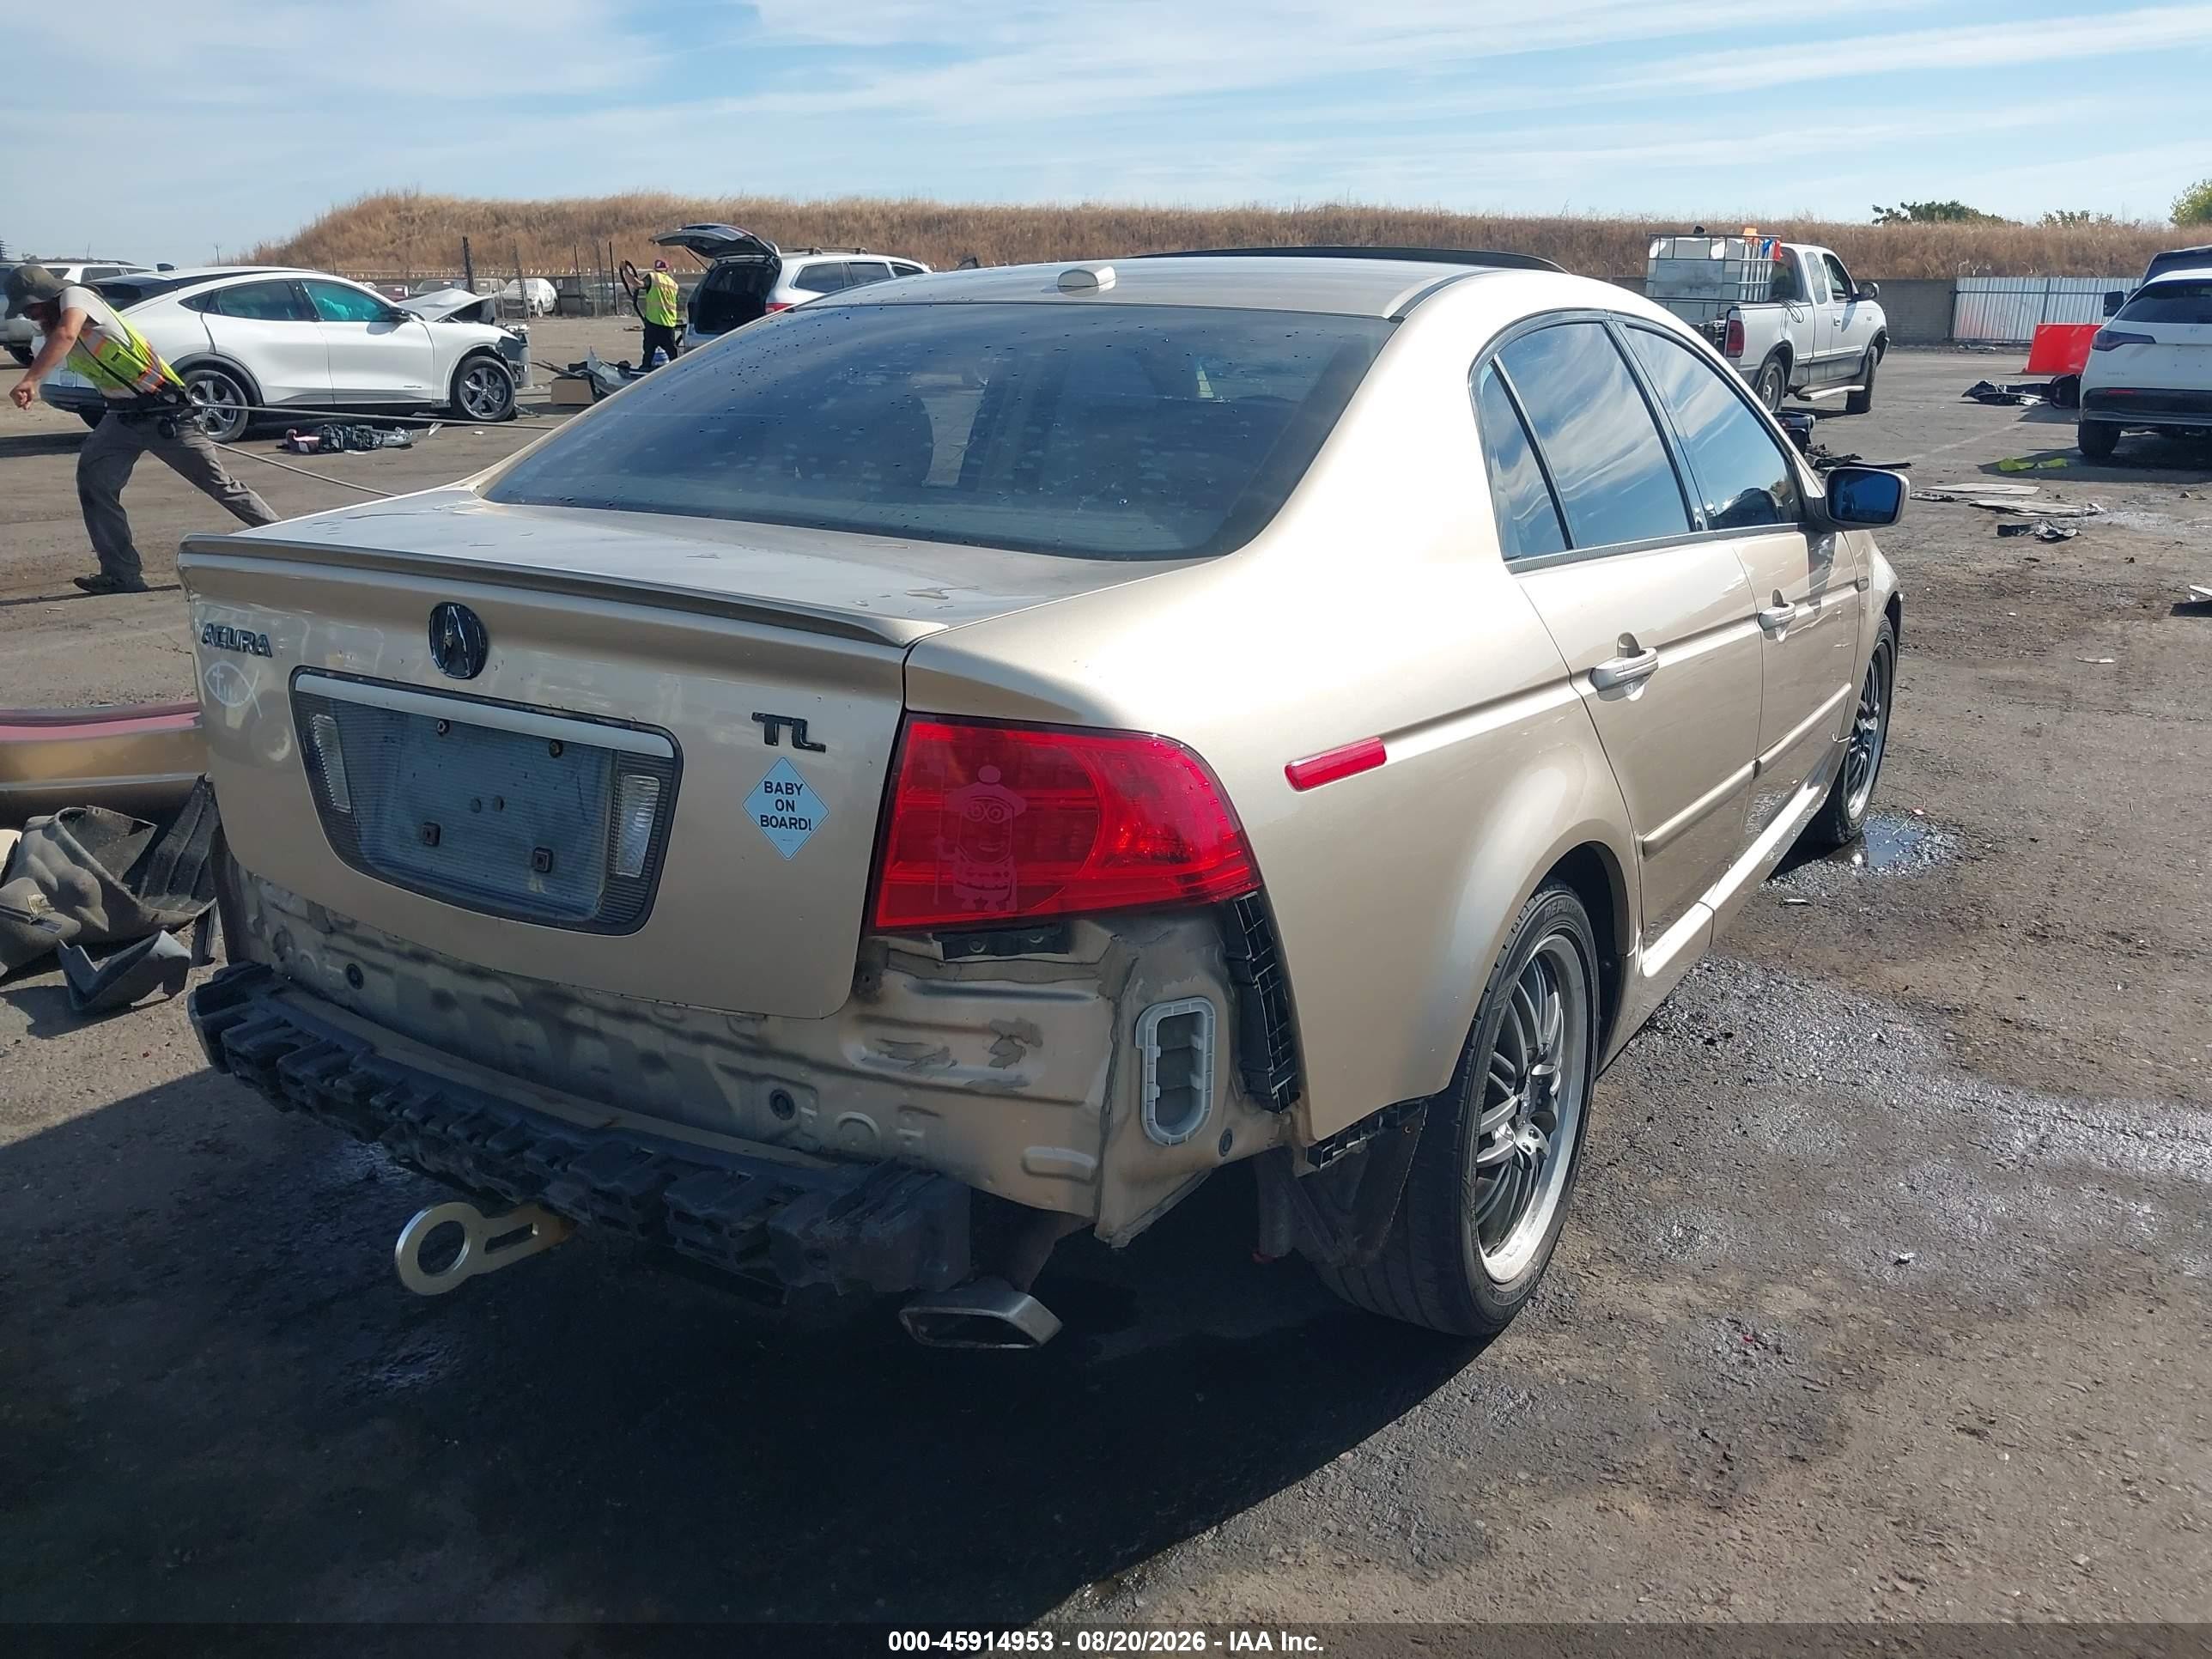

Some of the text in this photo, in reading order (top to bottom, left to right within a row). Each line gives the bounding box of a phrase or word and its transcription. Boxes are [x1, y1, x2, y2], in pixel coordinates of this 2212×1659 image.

[201, 623, 273, 659] ACURA
[751, 711, 827, 754] TL
[763, 781, 804, 796] BABY
[775, 799, 795, 813] ON
[760, 814, 812, 832] BOARD!
